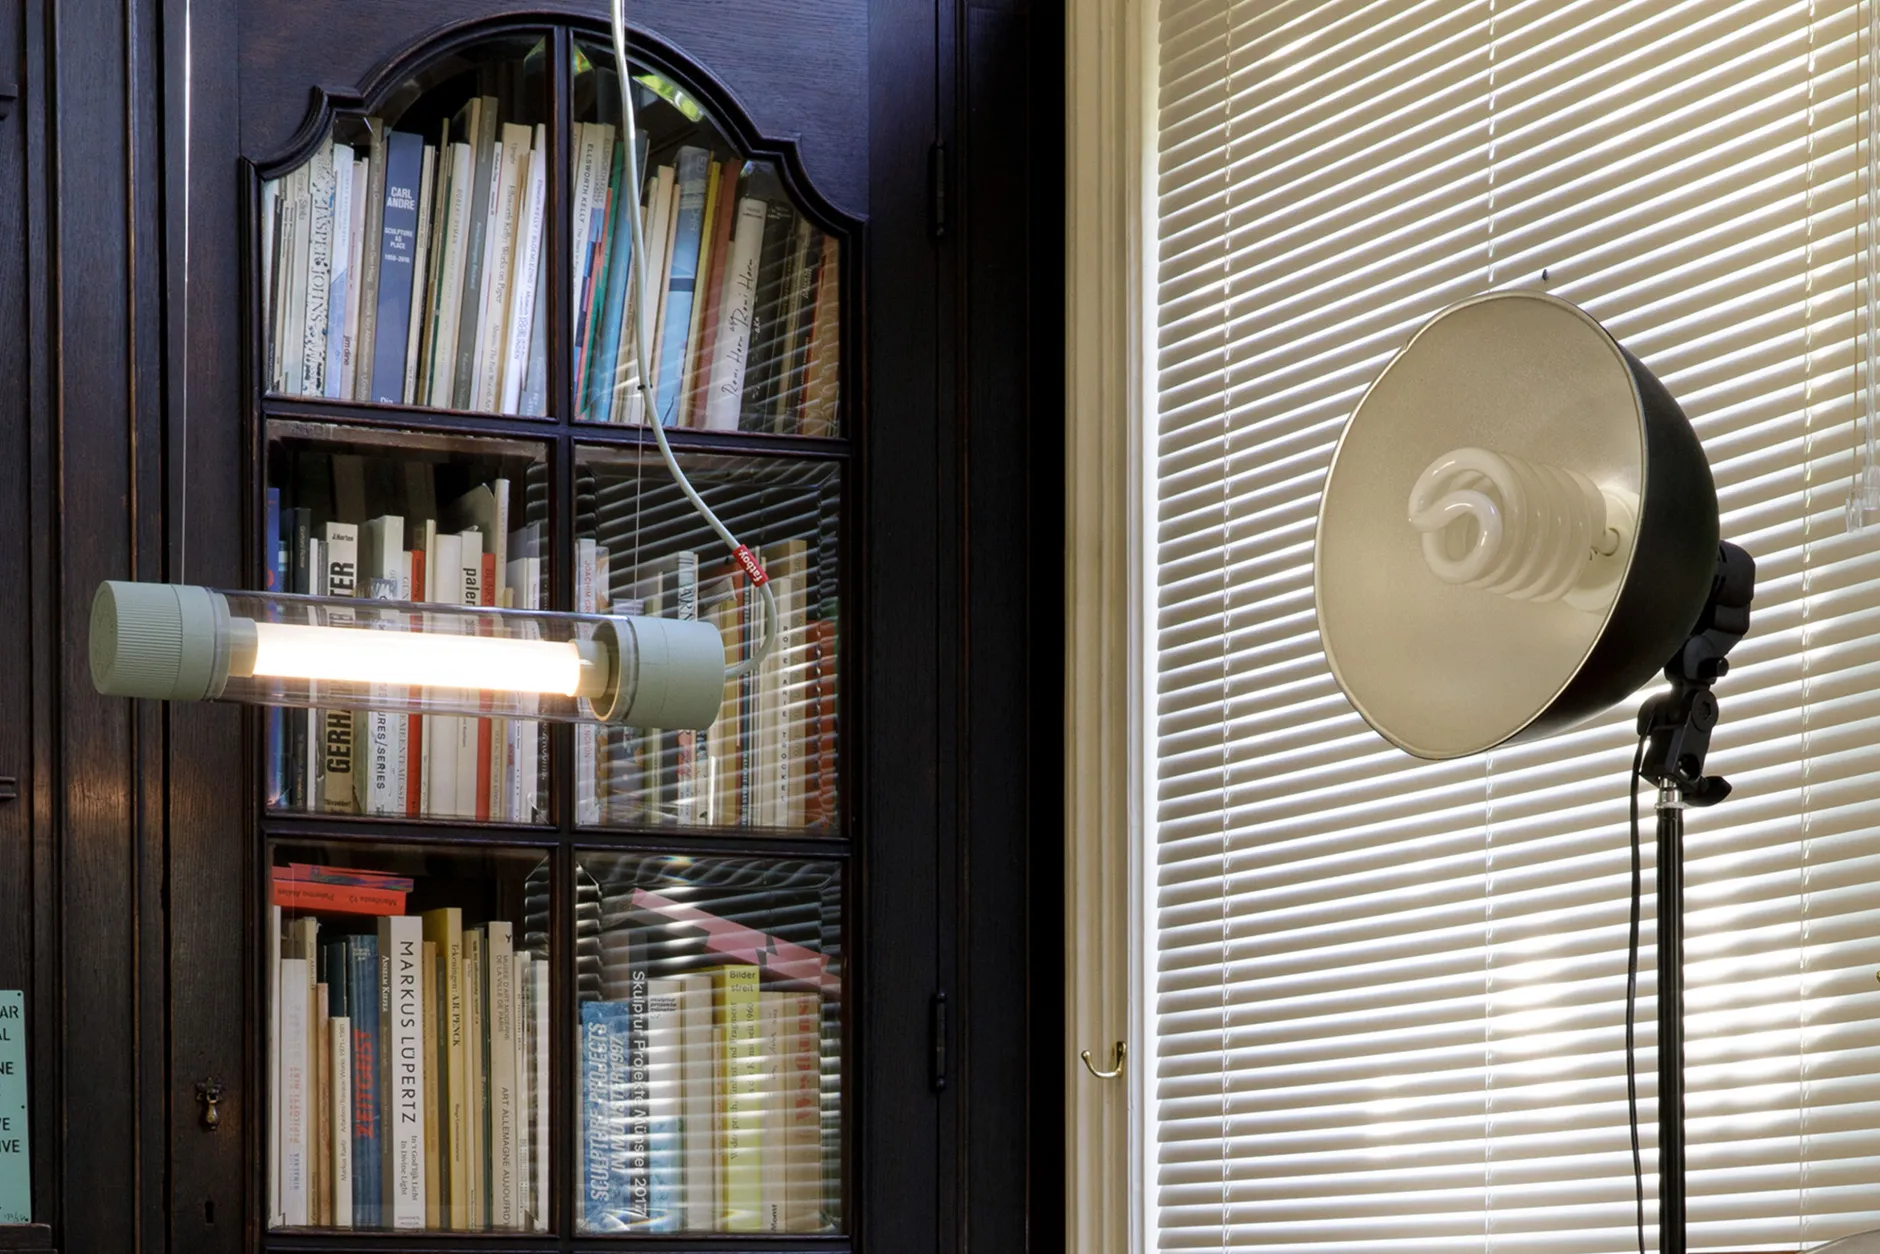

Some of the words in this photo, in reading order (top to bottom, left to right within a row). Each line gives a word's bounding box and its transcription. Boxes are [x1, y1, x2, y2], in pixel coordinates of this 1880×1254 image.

[581, 142, 593, 194] ELLSWORTH
[387, 196, 415, 210] ANDRE
[391, 187, 412, 199] CARL
[503, 184, 515, 220] Ellsworth
[578, 196, 588, 223] KELLY
[312, 205, 328, 262] JASPER
[384, 227, 412, 237] SCULPTURE
[390, 240, 406, 249] PLACE
[498, 245, 508, 269] Works
[309, 267, 326, 321] JOHNS
[494, 281, 504, 304] Paper
[342, 335, 352, 347] jim
[343, 348, 351, 365] dine
[483, 568, 493, 604] BLINKY
[325, 709, 352, 773] GERH
[302, 890, 334, 901] Palermo
[349, 895, 358, 904] 12
[360, 896, 397, 907] Manifesta
[450, 943, 460, 992] Tekeningen:
[496, 954, 502, 964] DE
[496, 966, 502, 976] LA
[729, 970, 756, 980] Bilder
[400, 940, 415, 1028] MARKUS
[497, 998, 503, 1009] DE
[631, 970, 645, 1033] Skulptur
[451, 1013, 460, 1047] PENCK
[588, 1021, 607, 1103] PROJECTS
[353, 1027, 374, 1139] ZEITGEIST
[400, 1035, 415, 1123] LÜPERTZ
[500, 1086, 508, 1106] ART
[400, 1140, 407, 1148] In
[411, 1135, 418, 1143] In
[501, 1108, 509, 1166] ALLEMAGNE
[633, 1109, 646, 1172] Münster
[398, 1175, 407, 1195] Light
